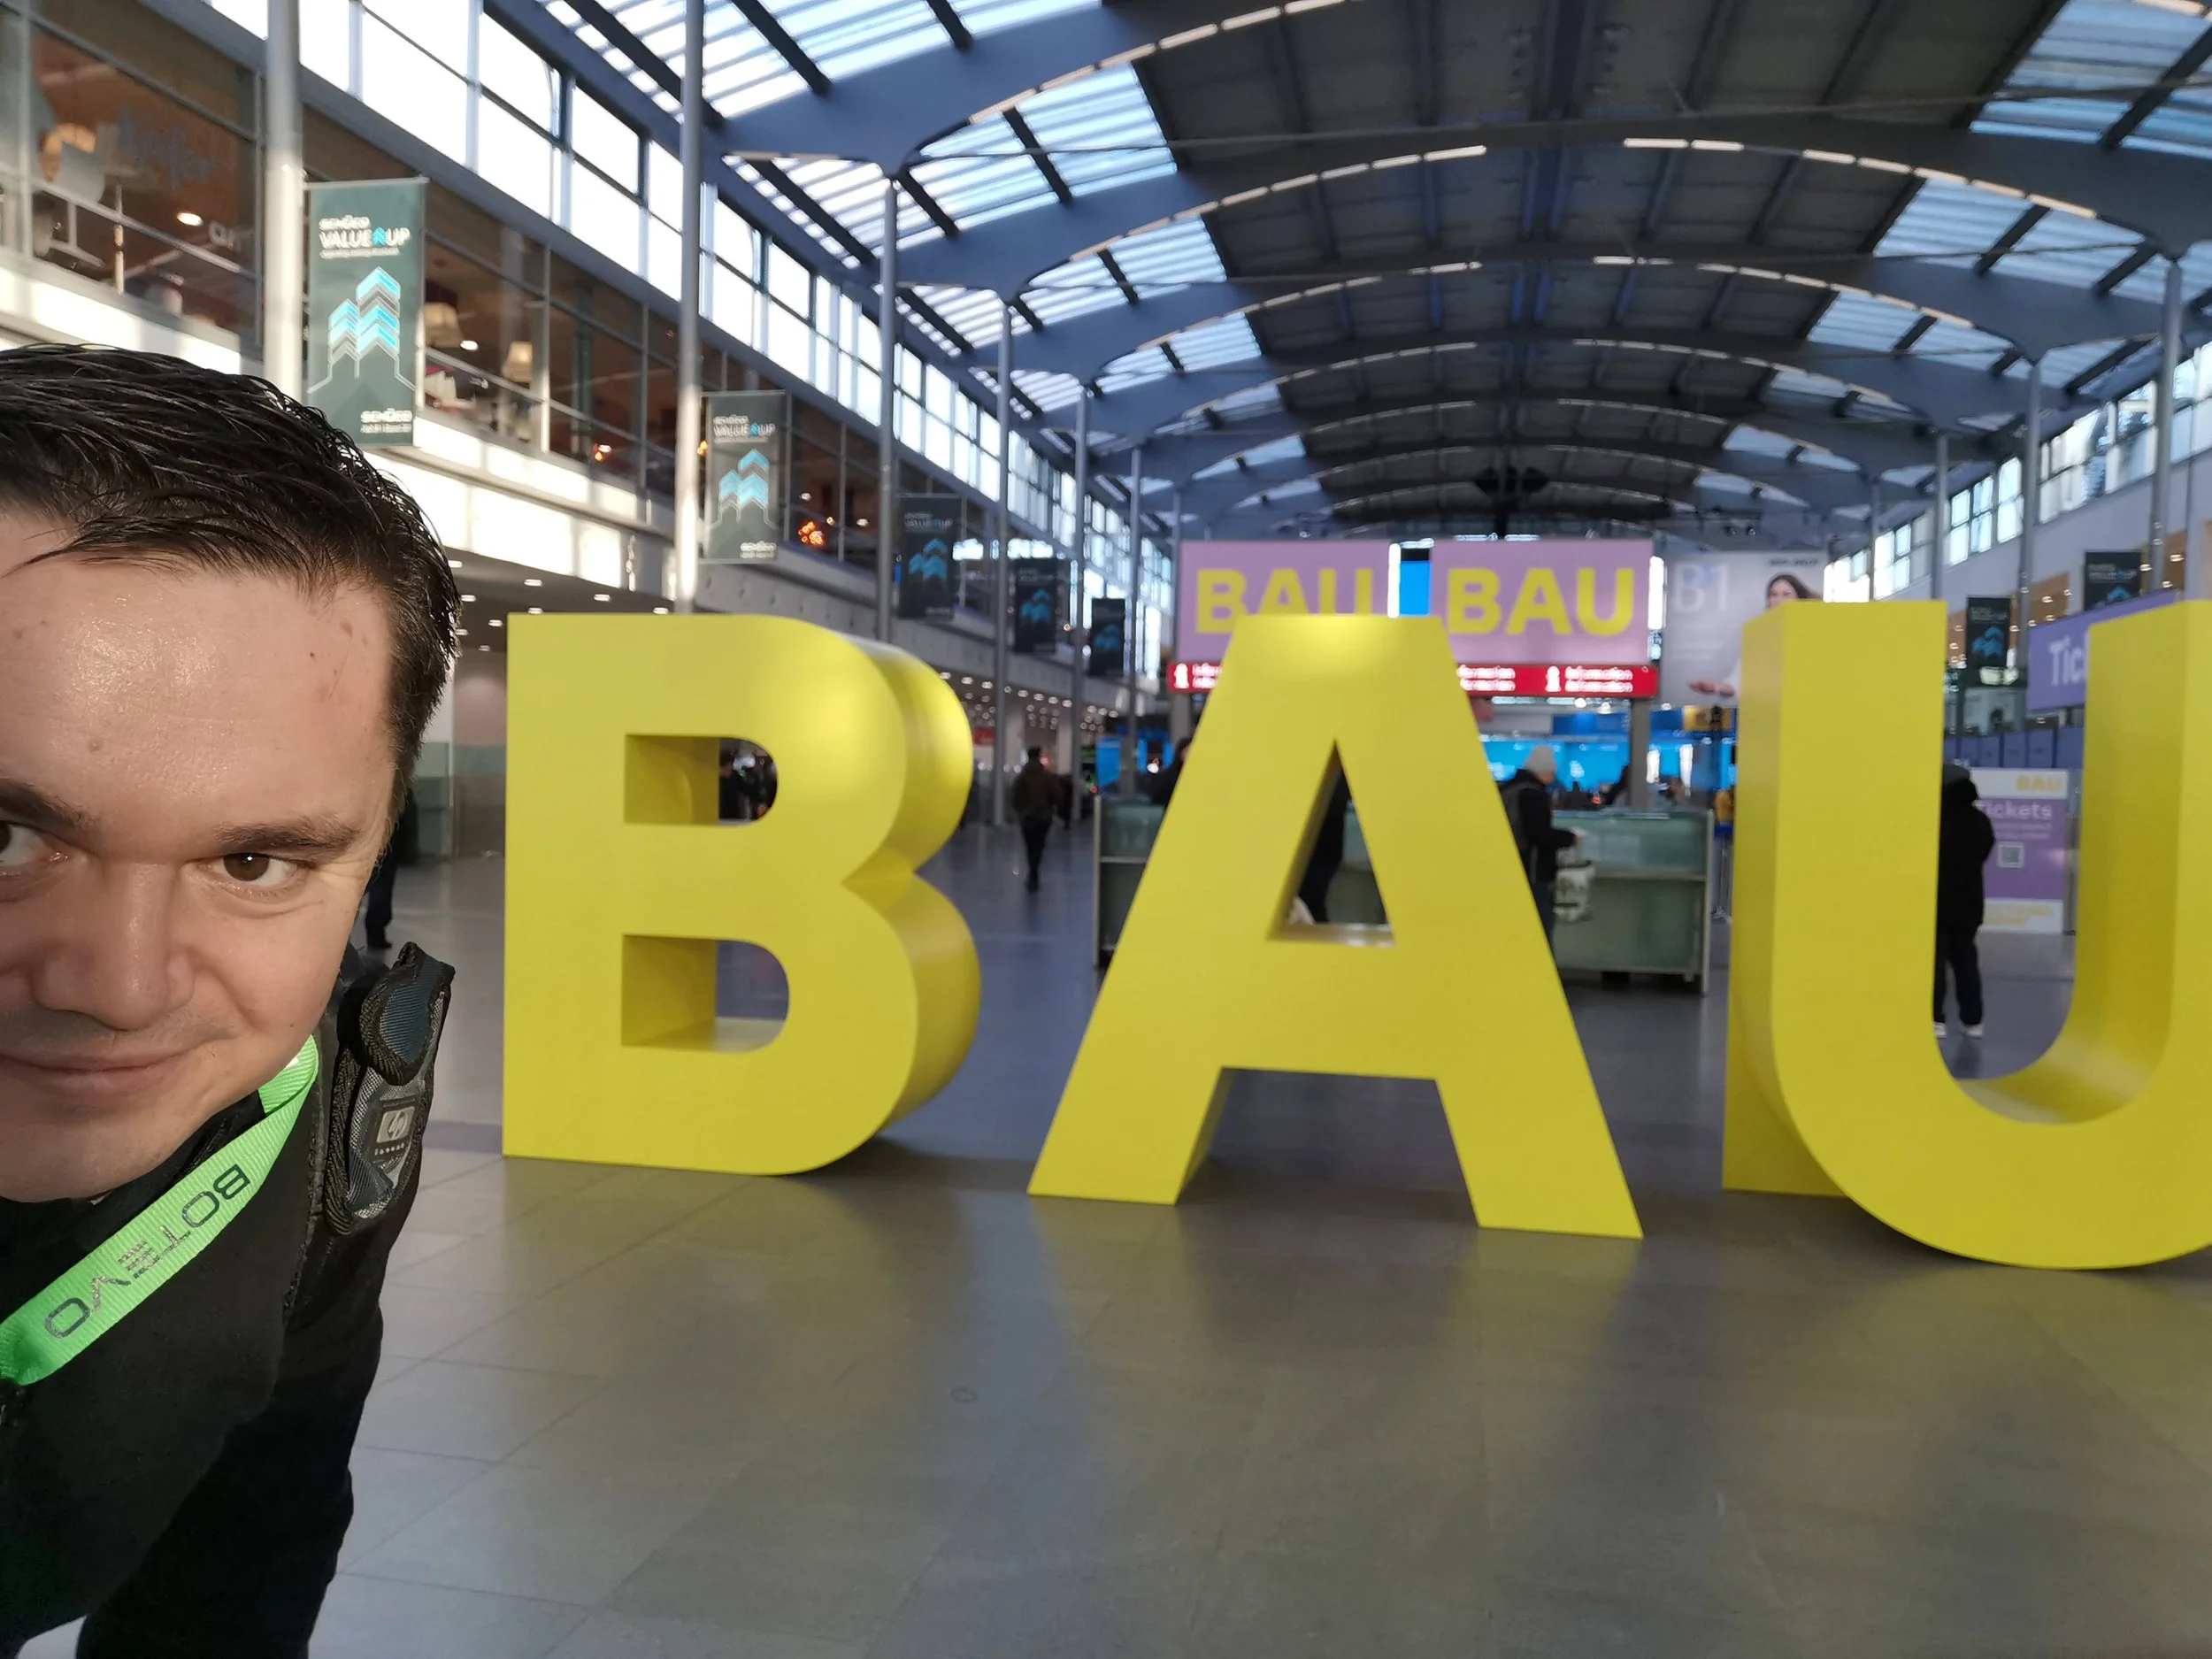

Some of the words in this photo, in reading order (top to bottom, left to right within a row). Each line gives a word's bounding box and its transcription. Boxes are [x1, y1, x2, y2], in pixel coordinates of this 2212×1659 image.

[319, 228, 373, 250] VALUE
[386, 227, 411, 247] UP
[1447, 568, 1635, 635] BAU
[2048, 631, 2089, 686] Tic
[502, 598, 2212, 1271] BAU
[44, 1164, 250, 1338] BOTEVO
